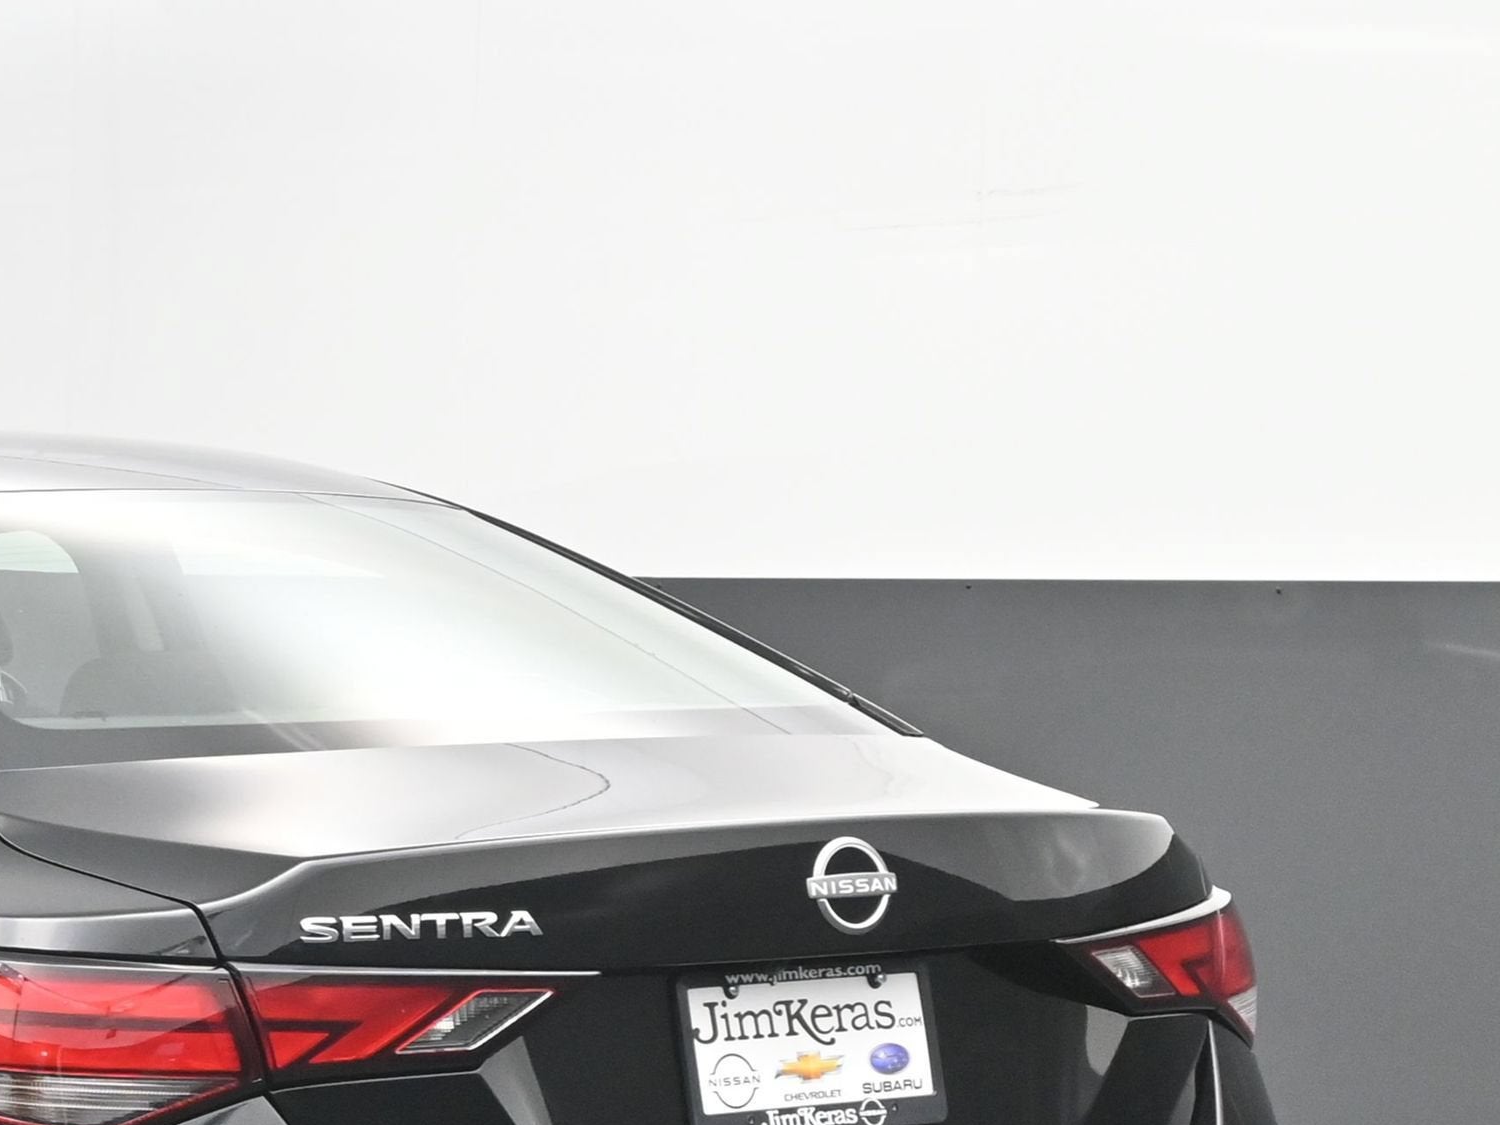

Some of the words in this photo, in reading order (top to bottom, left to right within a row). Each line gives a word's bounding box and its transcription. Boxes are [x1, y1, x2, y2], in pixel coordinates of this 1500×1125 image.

[810, 876, 897, 897] NISSAN
[299, 910, 544, 944] SENTRA
[725, 963, 882, 985] www.jimkeras.com
[708, 1075, 761, 1087] NISSAN
[862, 1079, 923, 1094] SUBARU
[783, 1089, 842, 1102] CHEVROLET
